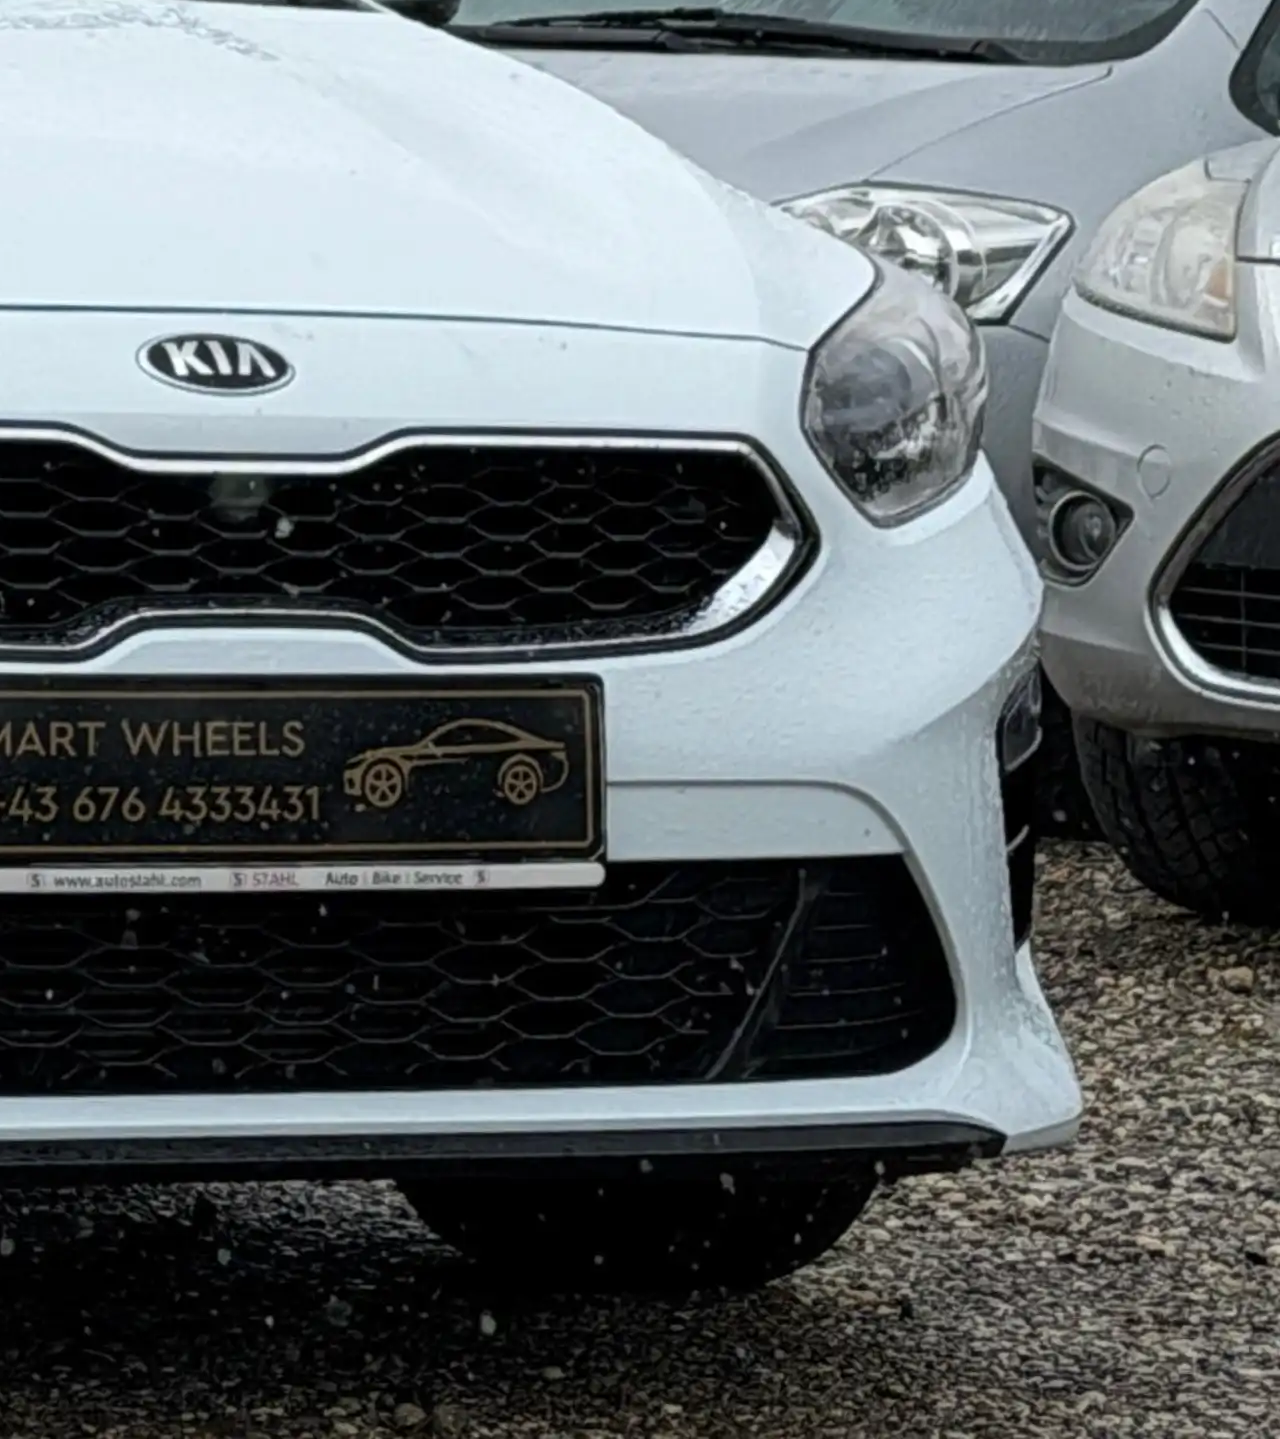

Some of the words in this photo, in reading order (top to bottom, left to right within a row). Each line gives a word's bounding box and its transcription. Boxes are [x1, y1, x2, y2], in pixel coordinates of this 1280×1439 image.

[161, 339, 277, 378] KIA
[120, 719, 306, 758] WHEELS
[72, 785, 147, 822] 676
[158, 785, 321, 822] 4333431
[252, 872, 299, 887] STAHL
[324, 871, 359, 886] Auto
[371, 870, 401, 885] Bike
[413, 870, 463, 886] Service
